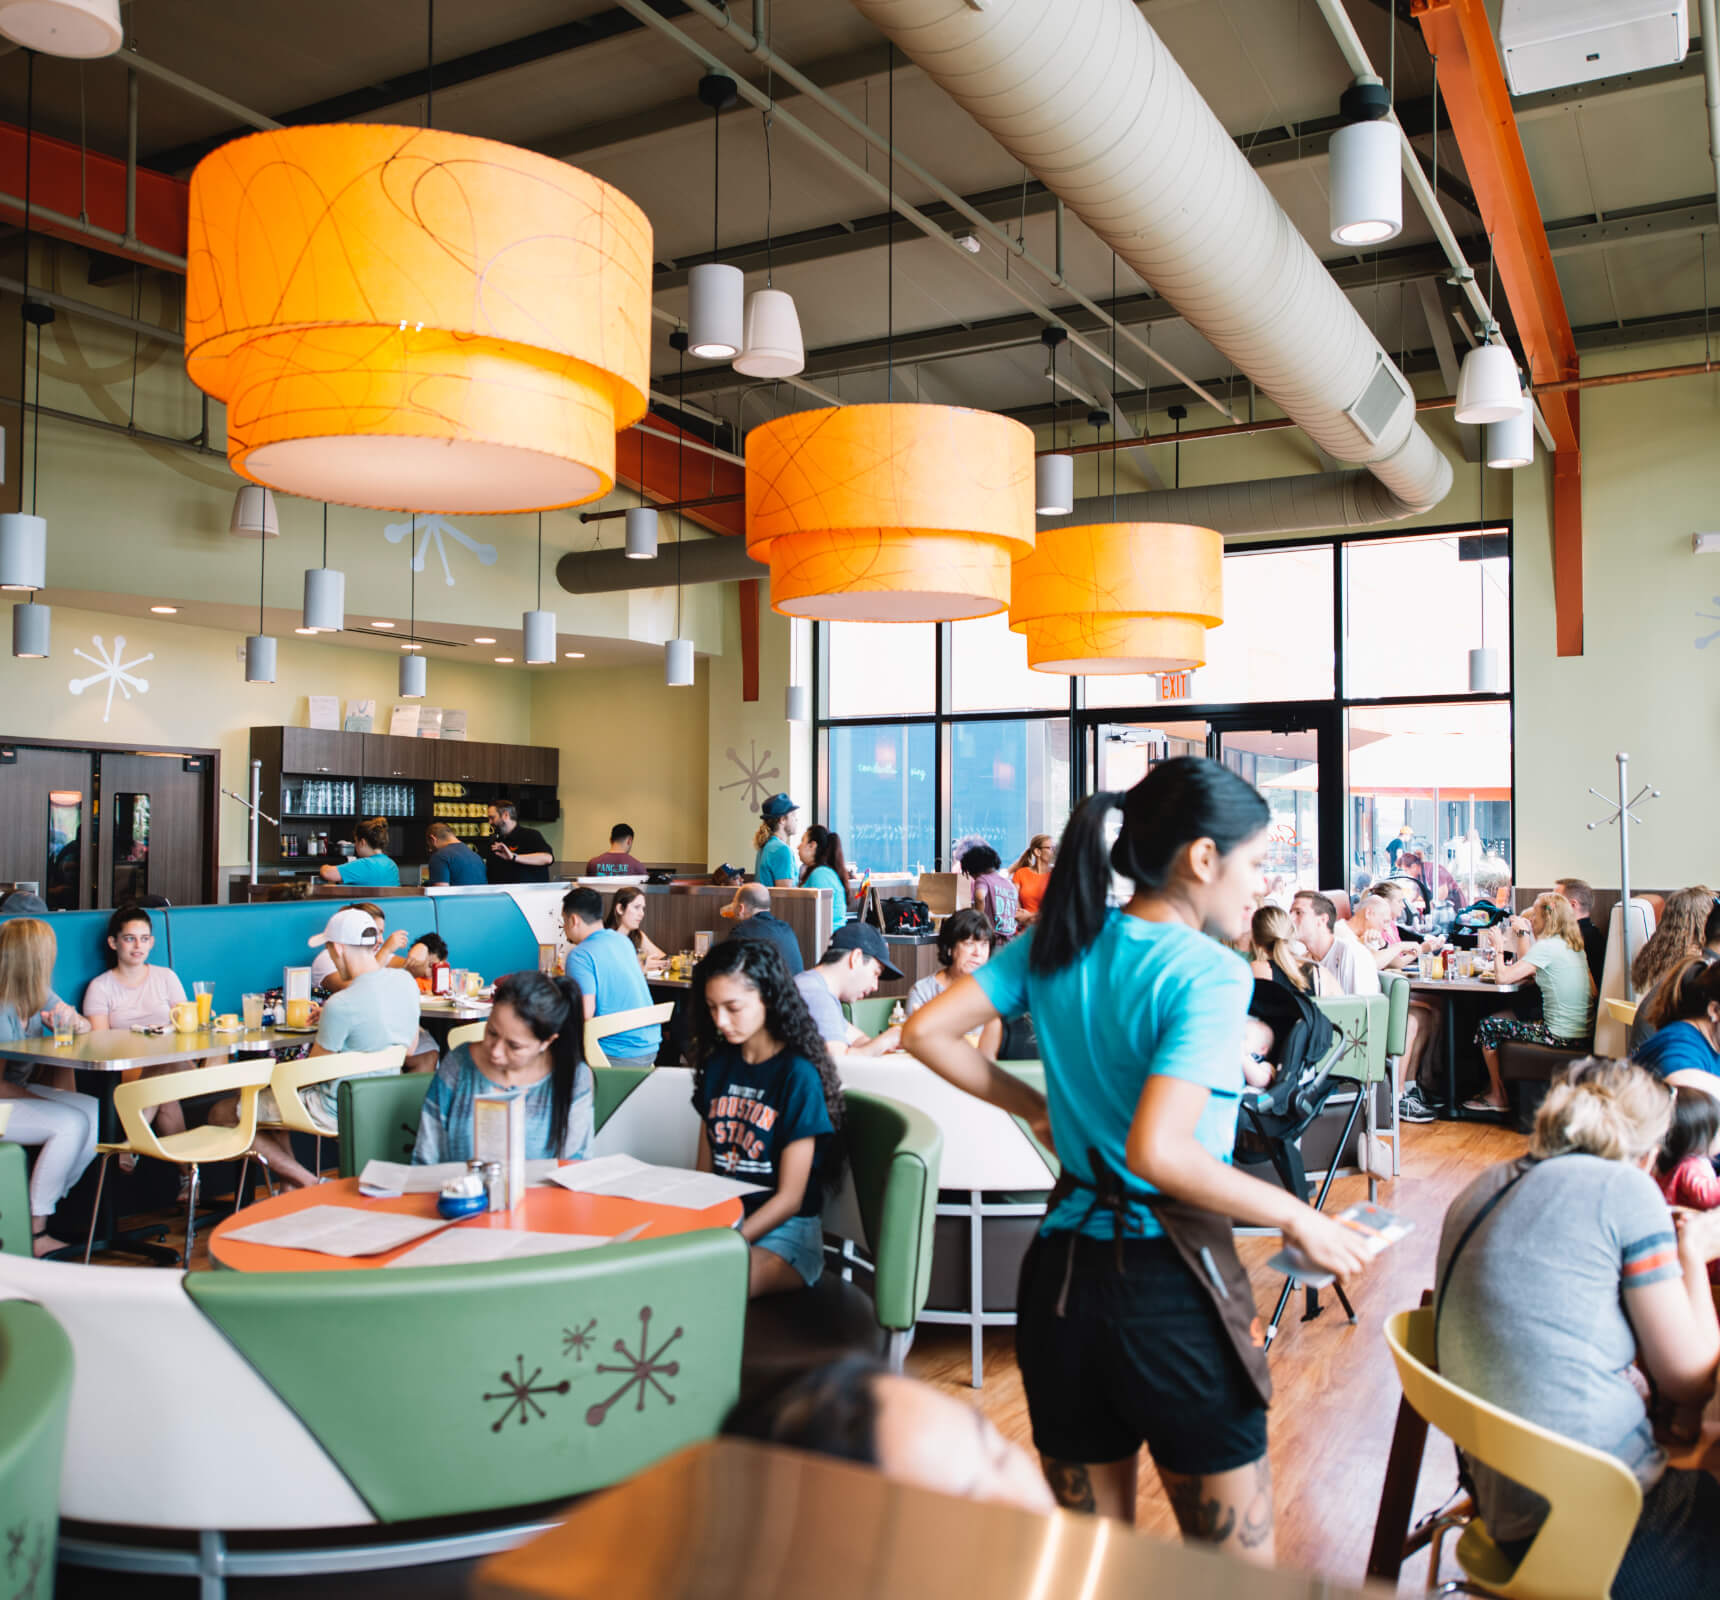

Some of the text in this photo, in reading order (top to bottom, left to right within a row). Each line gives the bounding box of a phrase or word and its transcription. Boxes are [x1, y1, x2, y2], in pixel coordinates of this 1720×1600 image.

[1161, 674, 1187, 700] EXIT
[708, 1096, 779, 1132] HOUSTON
[709, 1120, 765, 1160] STROS
